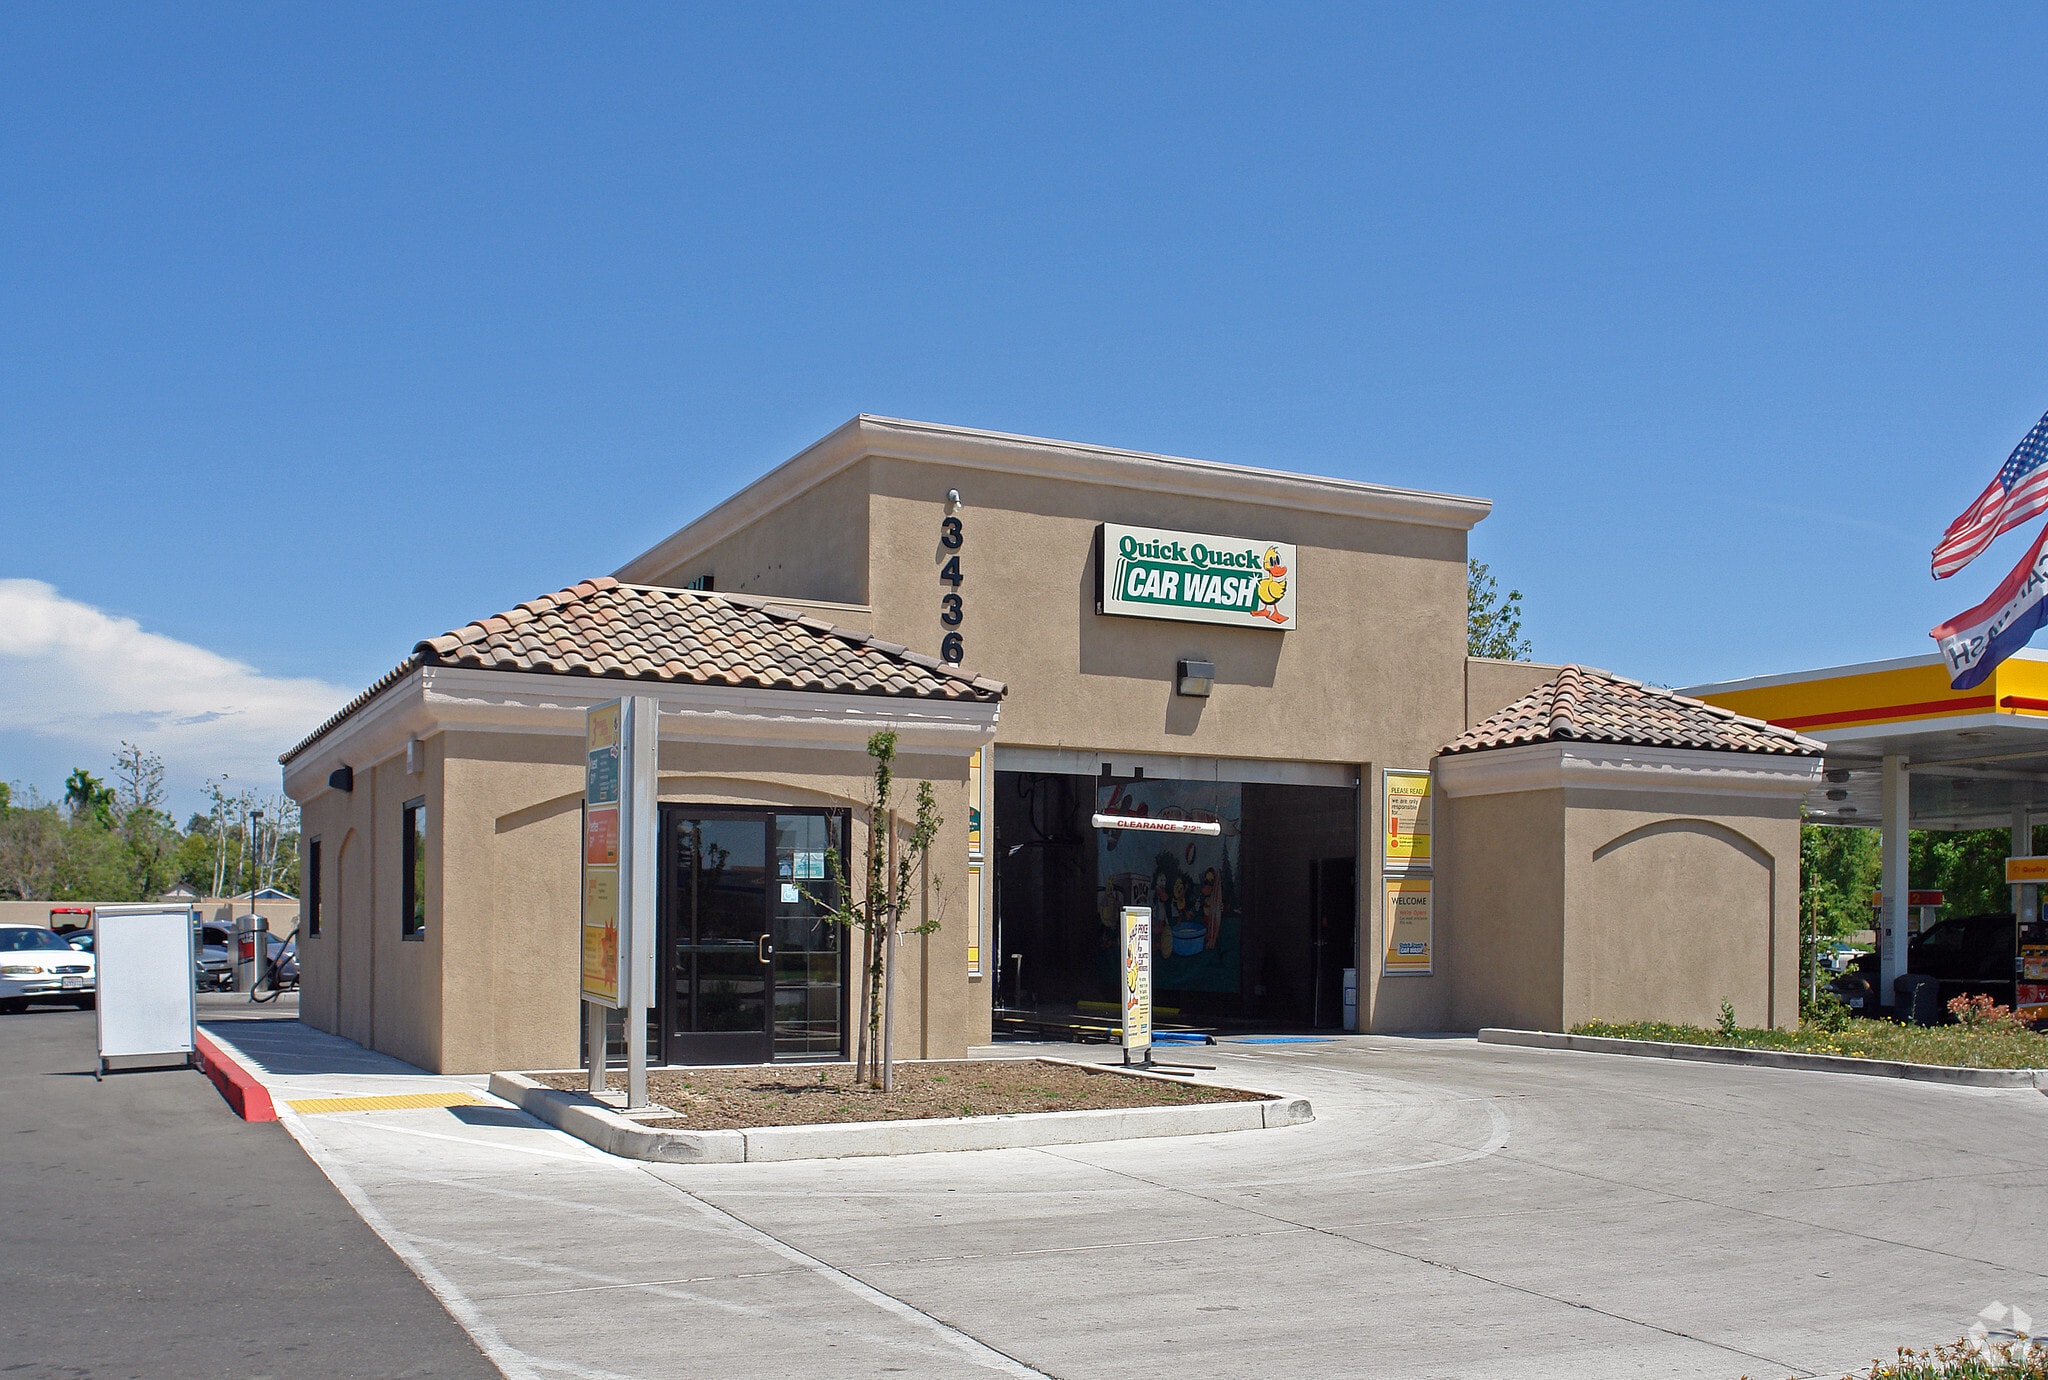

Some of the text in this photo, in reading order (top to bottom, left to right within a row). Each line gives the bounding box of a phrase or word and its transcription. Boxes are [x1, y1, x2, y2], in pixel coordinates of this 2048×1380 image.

[1119, 535, 1262, 569] Quick Quack
[941, 516, 964, 663] 3436
[1126, 567, 1256, 608] CAR WASH
[1117, 820, 1177, 831] CLEARANCE
[1391, 897, 1427, 905] WELCOME
[1912, 894, 1921, 904] 2
